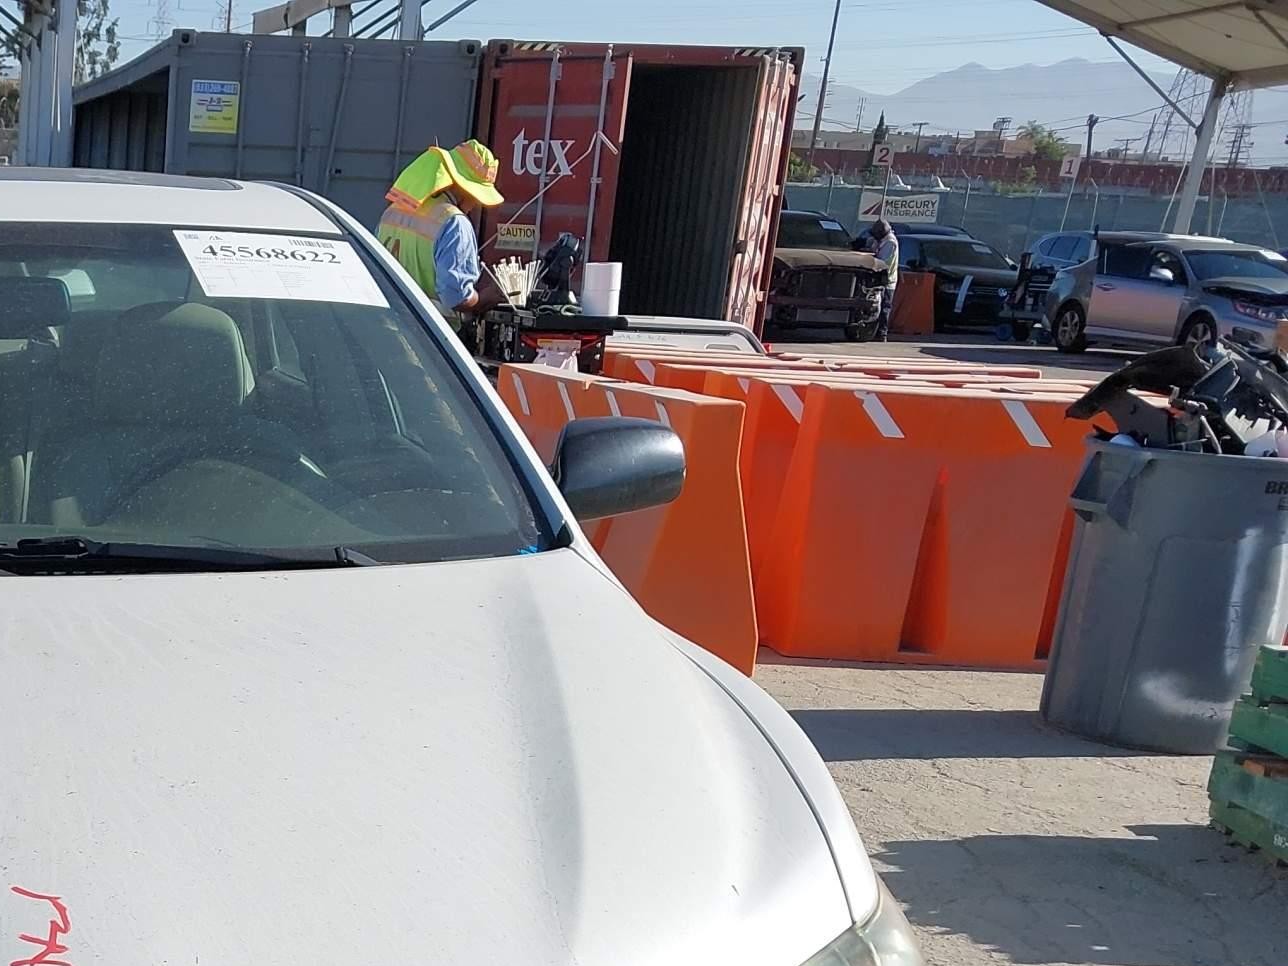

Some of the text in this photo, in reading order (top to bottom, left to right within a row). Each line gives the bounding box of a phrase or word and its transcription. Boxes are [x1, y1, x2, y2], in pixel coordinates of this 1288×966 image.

[877, 147, 890, 163] 2
[1064, 159, 1074, 175] 1
[883, 208, 937, 217] INSURANCE
[884, 200, 938, 209] MERCURY
[202, 244, 341, 264] 45568622
